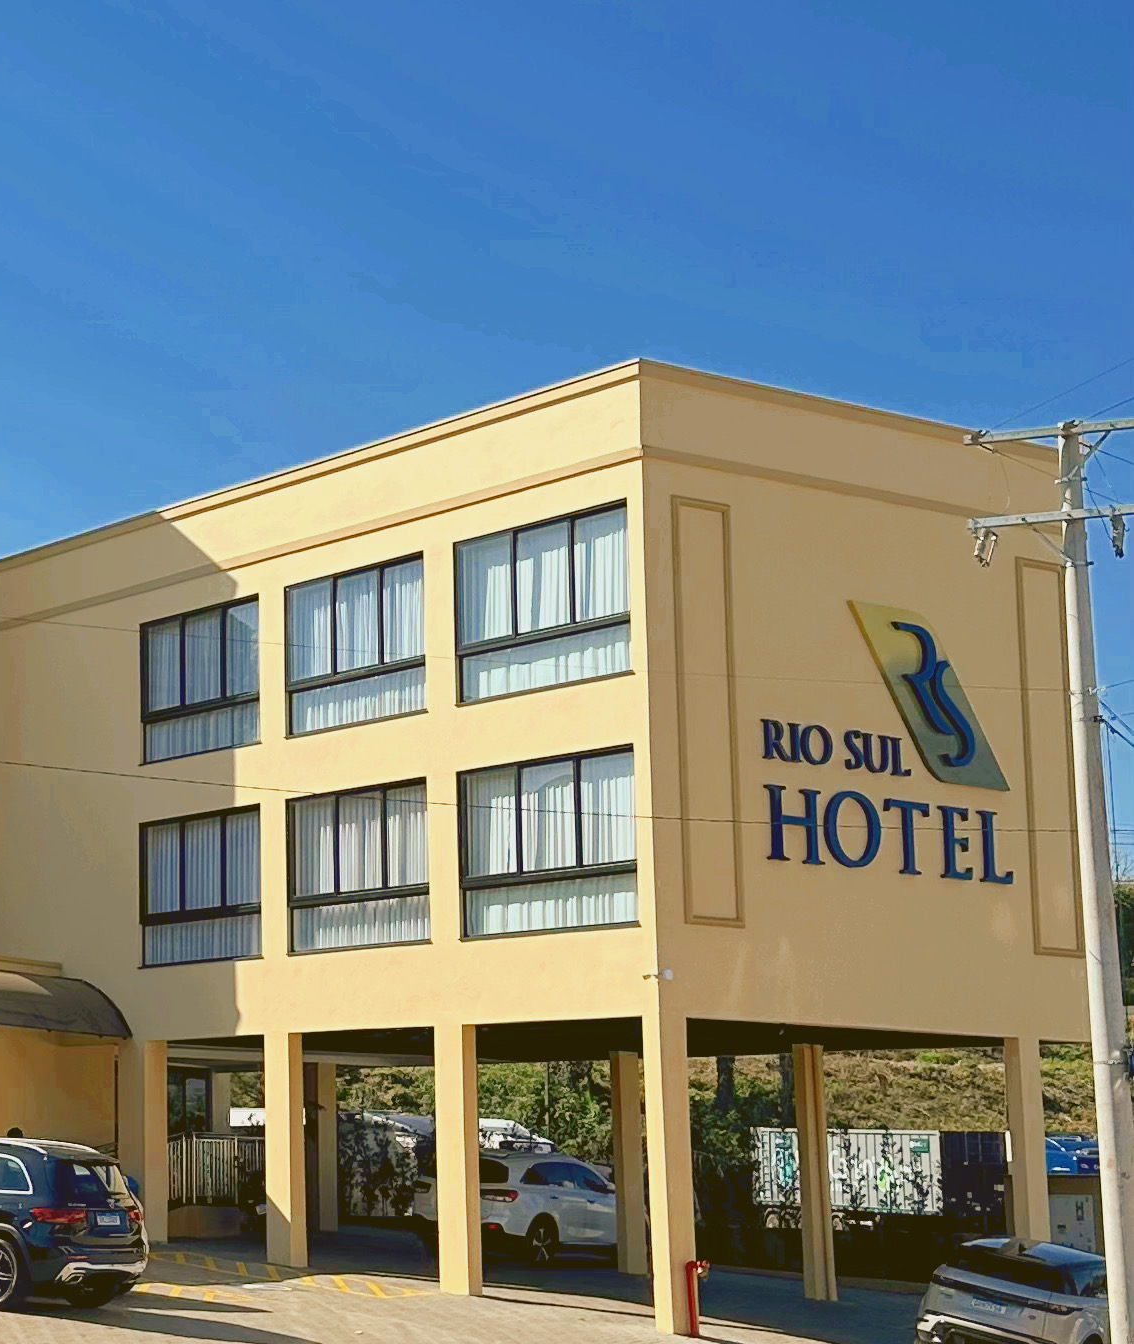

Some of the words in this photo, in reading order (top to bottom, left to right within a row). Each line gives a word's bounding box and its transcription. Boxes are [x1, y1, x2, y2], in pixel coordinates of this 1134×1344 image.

[760, 719, 833, 765] RIO
[843, 730, 912, 776] SUL
[763, 784, 1014, 885] HOTEL
